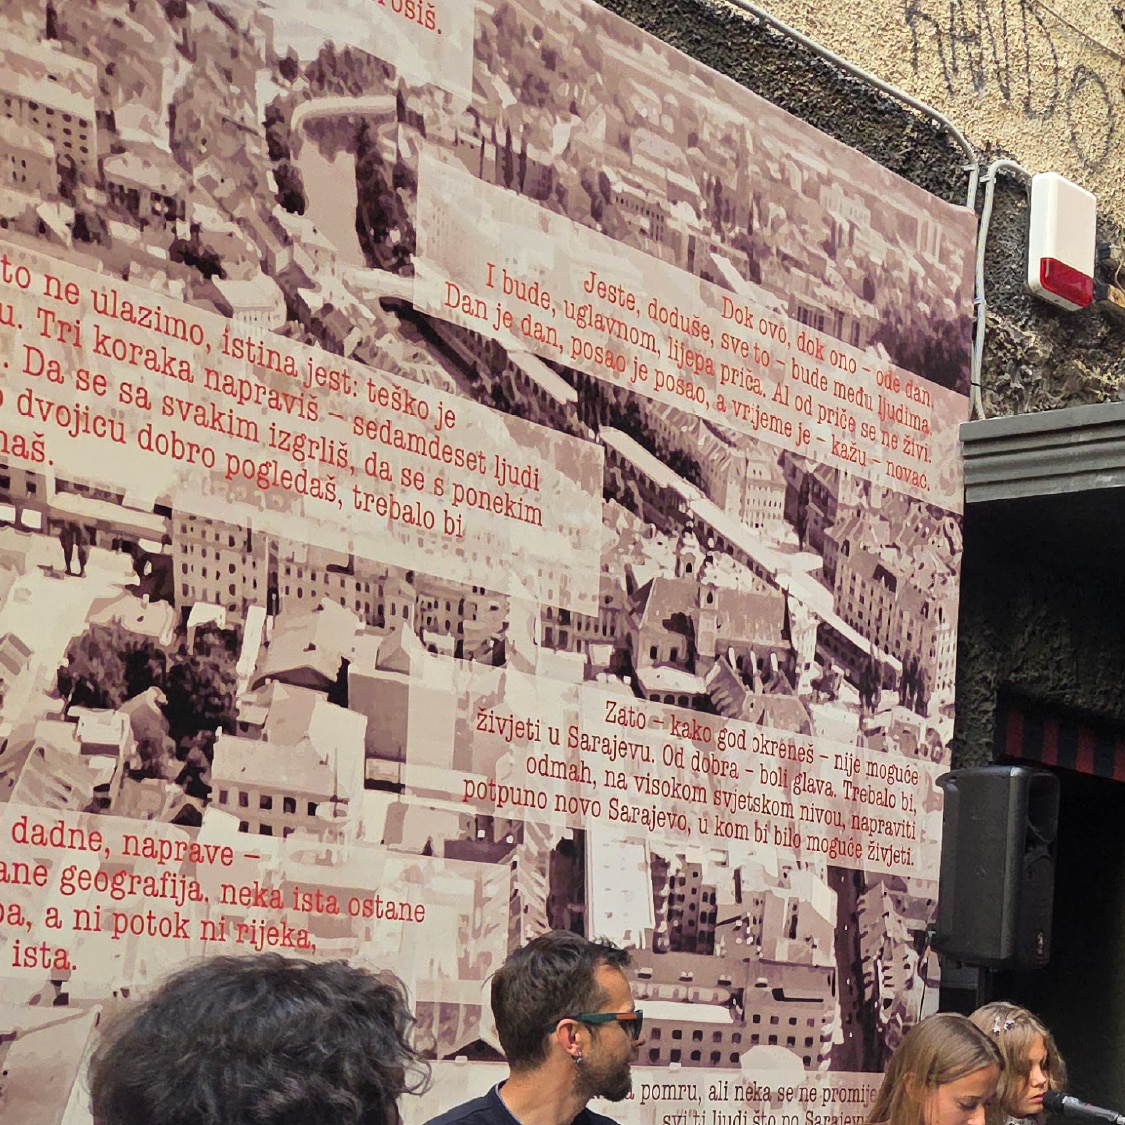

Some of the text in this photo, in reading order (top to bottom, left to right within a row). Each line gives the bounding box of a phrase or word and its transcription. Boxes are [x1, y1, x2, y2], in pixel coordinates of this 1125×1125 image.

[44, 274, 79, 304] ne
[92, 290, 210, 353] ulazimo,
[222, 327, 297, 377] istina
[304, 358, 357, 396] jest:
[368, 379, 428, 419] teško
[436, 402, 455, 430] je
[444, 282, 487, 320] Dan
[493, 304, 513, 330] je
[521, 314, 563, 350] dan,
[571, 336, 626, 372] posao
[631, 357, 648, 383] je
[654, 369, 709, 409] posao,
[716, 395, 726, 412] a
[732, 400, 792, 437] vrijeme
[796, 423, 810, 446] je
[832, 435, 866, 466] kažu
[887, 461, 929, 491] novac.
[486, 263, 931, 463] I bude, uglavnom, lijepa priča. Al od priče se ne živi.
[584, 272, 640, 315] Jeste,
[648, 298, 713, 345] doduše,
[721, 333, 749, 358] sve
[754, 345, 770, 367] to
[792, 358, 827, 391] bude
[834, 381, 872, 410] među
[878, 395, 932, 435] ljudima.
[722, 296, 753, 328] Dok
[760, 319, 790, 347] ovo,
[798, 332, 824, 360] dok
[830, 350, 856, 374] ono
[877, 371, 900, 392] ode
[23, 345, 542, 526] Da se sa svakim izgrliš, da se s ponekim
[37, 308, 81, 347] Tri
[94, 325, 194, 383] koraka
[204, 368, 318, 421] napraviš
[354, 416, 485, 474] sedamdeset
[495, 455, 539, 491] ljudi
[17, 389, 126, 444] dvojicu
[138, 424, 215, 468] dobro
[225, 453, 342, 508] pogledaš,
[353, 486, 434, 529] trebalo
[444, 510, 463, 538] bi
[477, 707, 540, 742] živjeti
[548, 727, 559, 745] u
[568, 726, 654, 762] Sarajevu.
[663, 744, 684, 769] Od
[692, 751, 739, 779] dobra
[760, 764, 788, 788] boli
[793, 772, 836, 797] glava.
[844, 780, 895, 808] Trebalo
[902, 792, 916, 816] bi,
[605, 701, 645, 729] Zato
[671, 714, 711, 742] kako
[718, 728, 746, 751] god
[834, 754, 860, 777] nije
[866, 762, 918, 785] moguće
[12, 816, 110, 858] dadne,
[123, 835, 233, 866] naprave
[463, 779, 915, 867] potpuno novo Sarajevo, u kom bi bilo moguće živjeti.
[527, 754, 915, 839] odmah, na visokom svjetskom nivou, napraviti
[0, 904, 316, 952] a, a ni potok ni rijeka,
[221, 881, 284, 909] neka
[294, 886, 339, 914] ista
[348, 897, 425, 922] ostane
[13, 940, 76, 970] ista.
[640, 1084, 701, 1105] pomru,
[709, 1081, 728, 1101] ali
[735, 1081, 772, 1101] neka
[778, 1087, 793, 1102] se
[799, 1088, 816, 1102] ne
